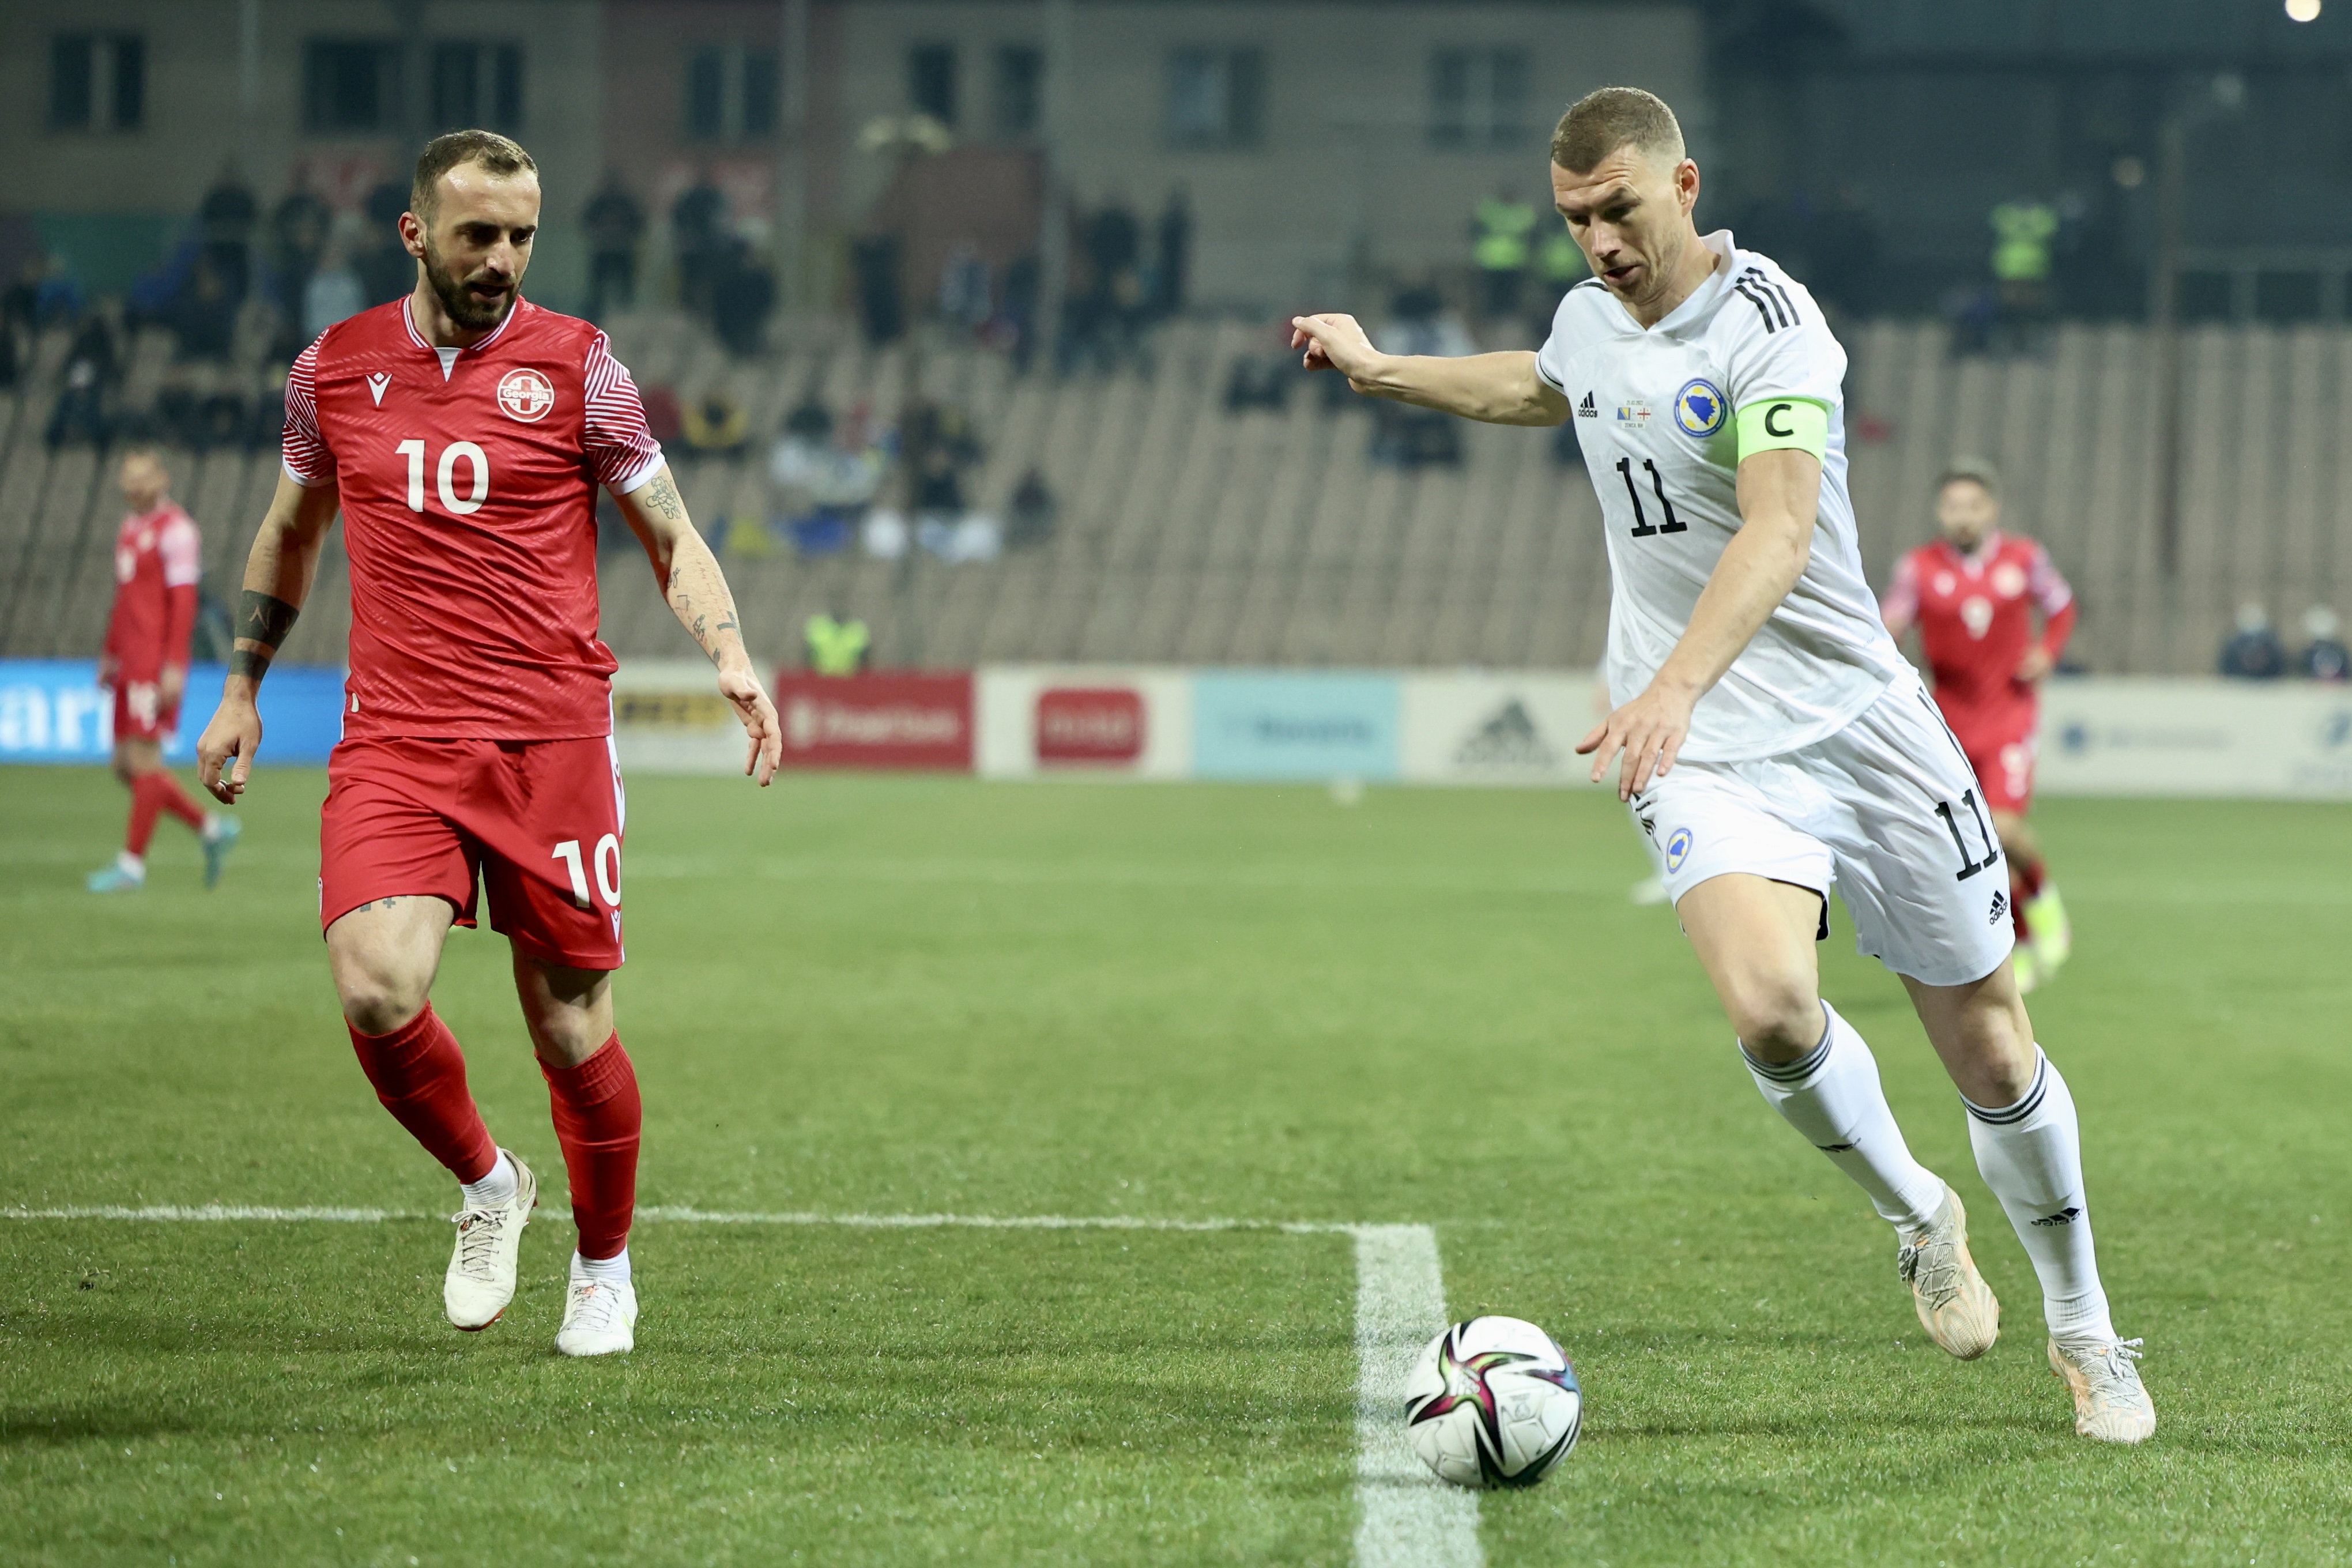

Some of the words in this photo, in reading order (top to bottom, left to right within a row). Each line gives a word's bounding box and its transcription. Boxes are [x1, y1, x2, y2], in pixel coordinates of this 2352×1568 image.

[503, 389, 549, 402] Georgia
[1578, 407, 1598, 418] adidas
[1765, 404, 1794, 437] C
[394, 439, 489, 515] 10
[1616, 457, 1687, 537] 11
[1935, 789, 1998, 881] 11
[552, 833, 621, 909] 10
[1989, 898, 2008, 925] adidas
